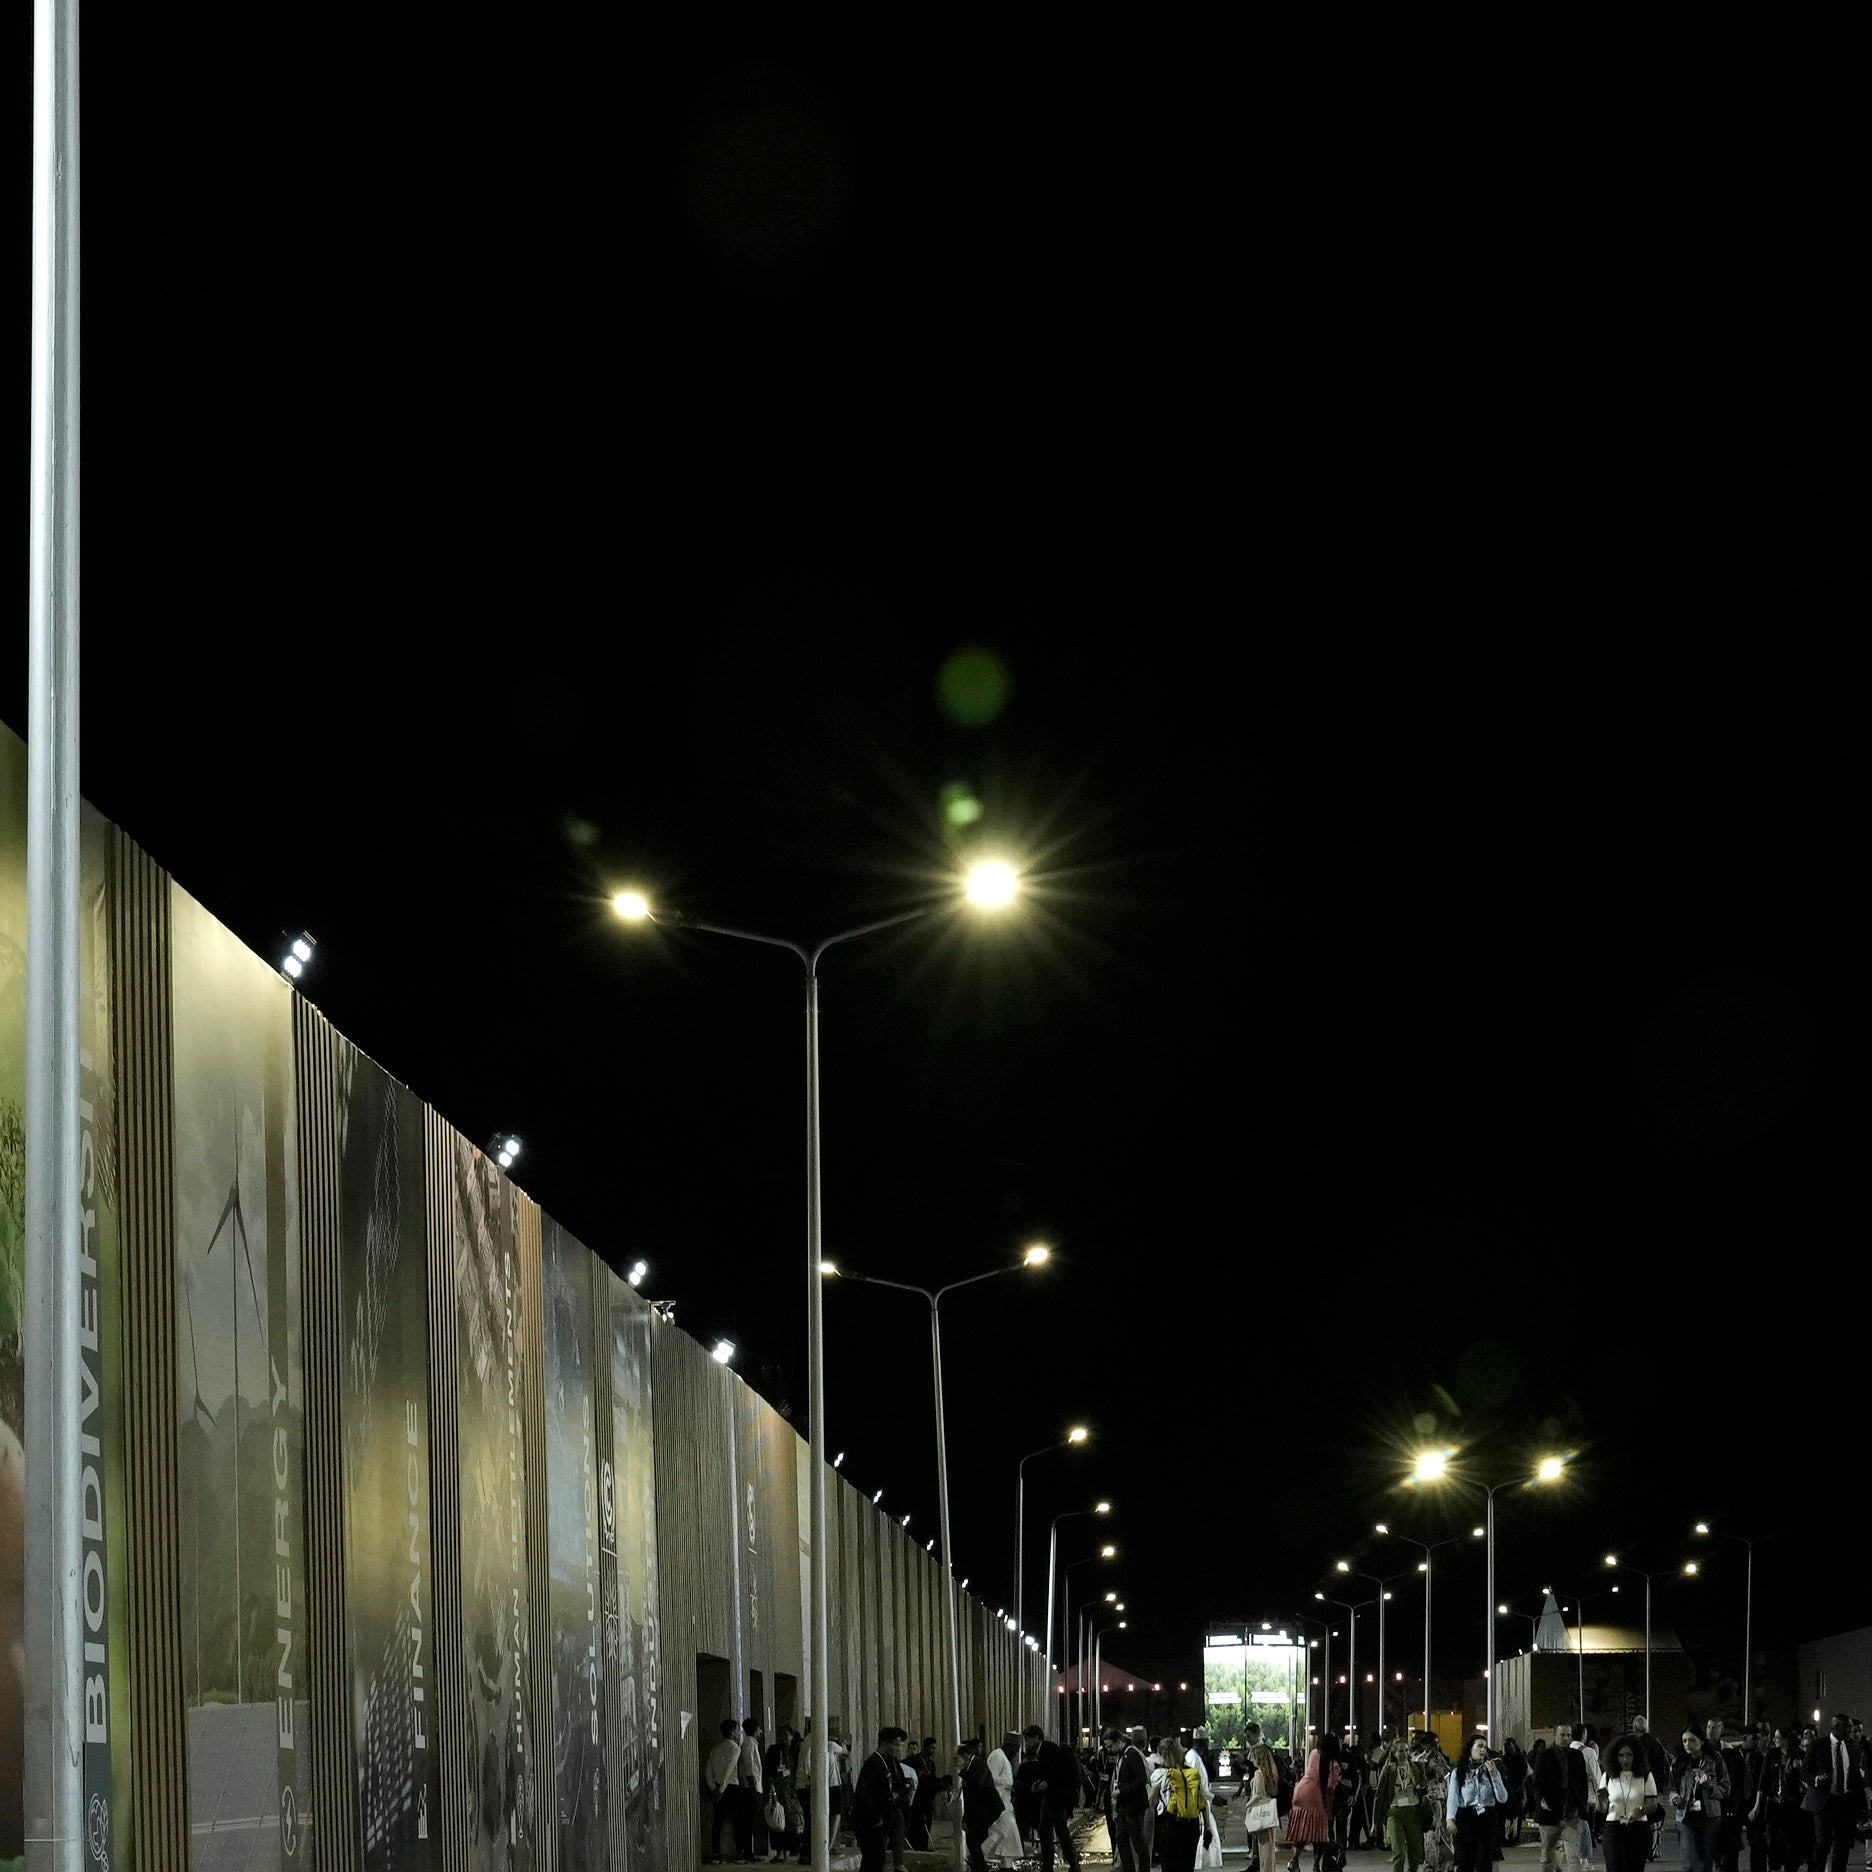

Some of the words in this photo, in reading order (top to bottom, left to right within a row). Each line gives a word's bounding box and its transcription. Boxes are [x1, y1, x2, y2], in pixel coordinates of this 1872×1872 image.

[271, 1355, 295, 1750] ENERGY
[406, 1399, 427, 1750] FINANCE
[504, 1252, 518, 1573] SETTLEMENTS
[584, 1394, 598, 1745] SOLUTIONS
[513, 1588, 522, 1752] HUMAN
